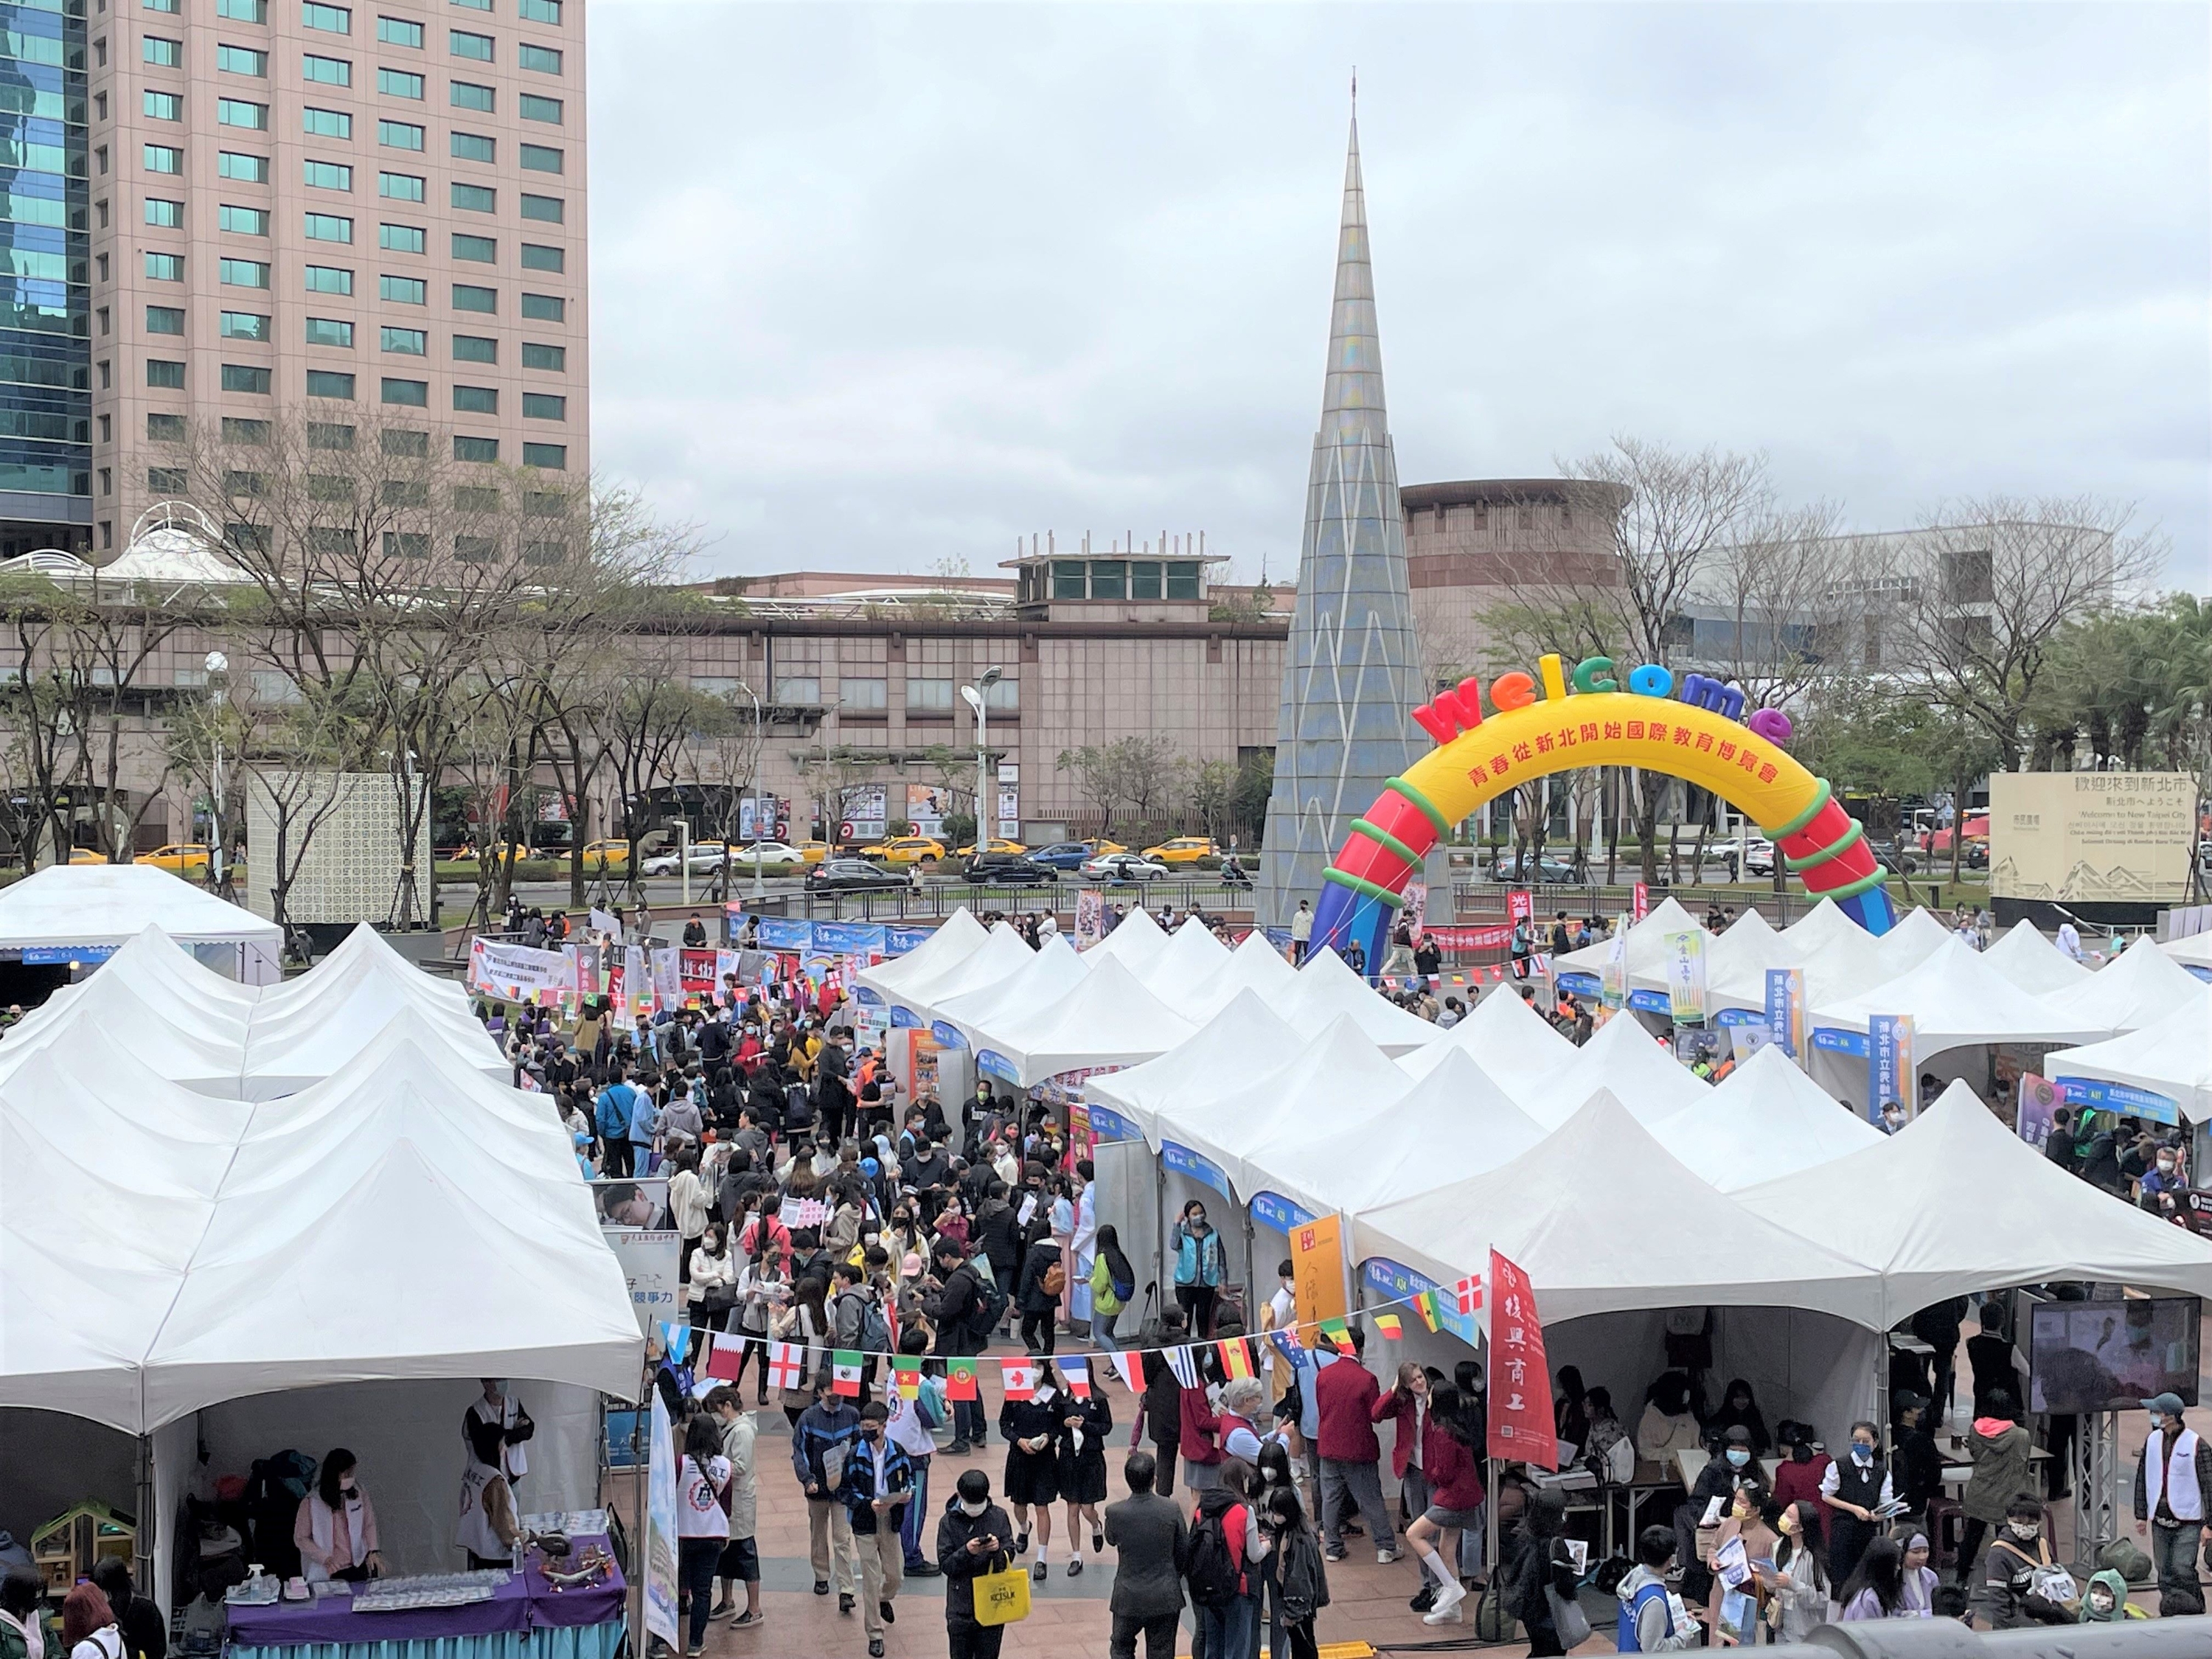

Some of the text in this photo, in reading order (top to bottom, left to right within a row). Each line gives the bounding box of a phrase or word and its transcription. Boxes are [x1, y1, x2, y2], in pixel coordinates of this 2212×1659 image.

[1411, 653, 1792, 748] Welcome
[1467, 720, 1780, 788] 青春從新北開始國際教育博覽會
[2075, 776, 2187, 792] 歡迎來到新北市
[2171, 811, 2186, 820] City
[629, 1292, 672, 1304] 競爭力
[687, 1463, 726, 1479] 三商工
